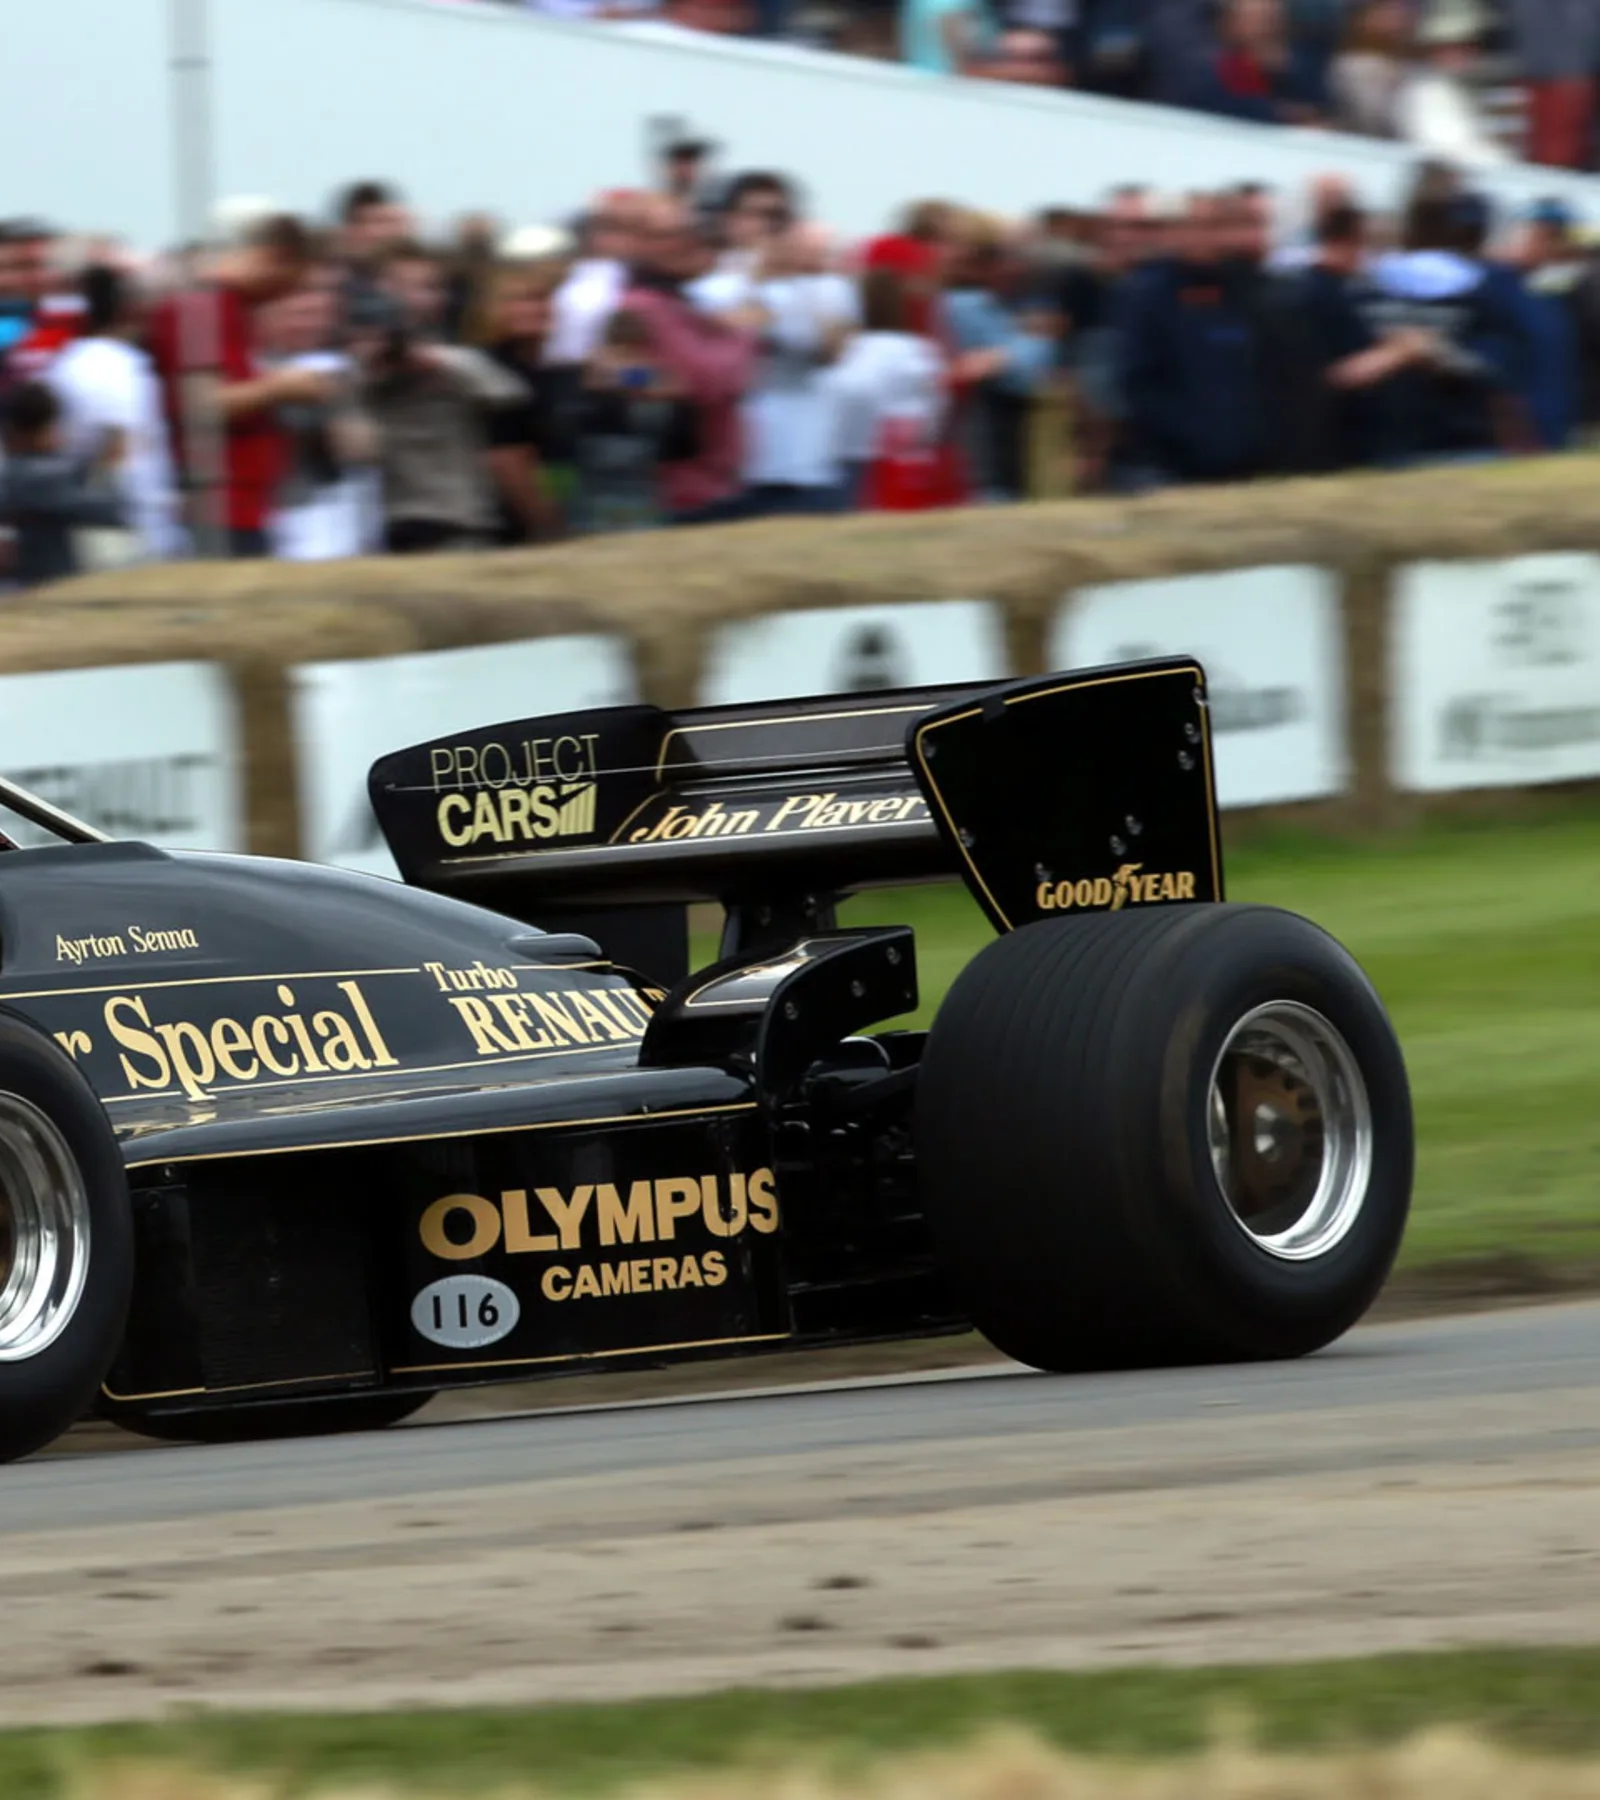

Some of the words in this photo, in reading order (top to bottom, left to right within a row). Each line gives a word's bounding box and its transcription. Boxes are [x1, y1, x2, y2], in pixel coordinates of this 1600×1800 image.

[430, 733, 600, 792] PROJECT
[437, 785, 563, 847] CARS
[629, 802, 759, 842] John
[1036, 863, 1196, 910] GOODYEAR
[55, 933, 127, 965] Ayrton
[128, 925, 199, 953] Senna
[423, 960, 519, 993] Turbo
[103, 980, 399, 1103] Special
[418, 1166, 781, 1261] OLYMPUS
[541, 1251, 728, 1302] CAMERAS
[433, 1292, 499, 1330] 116
